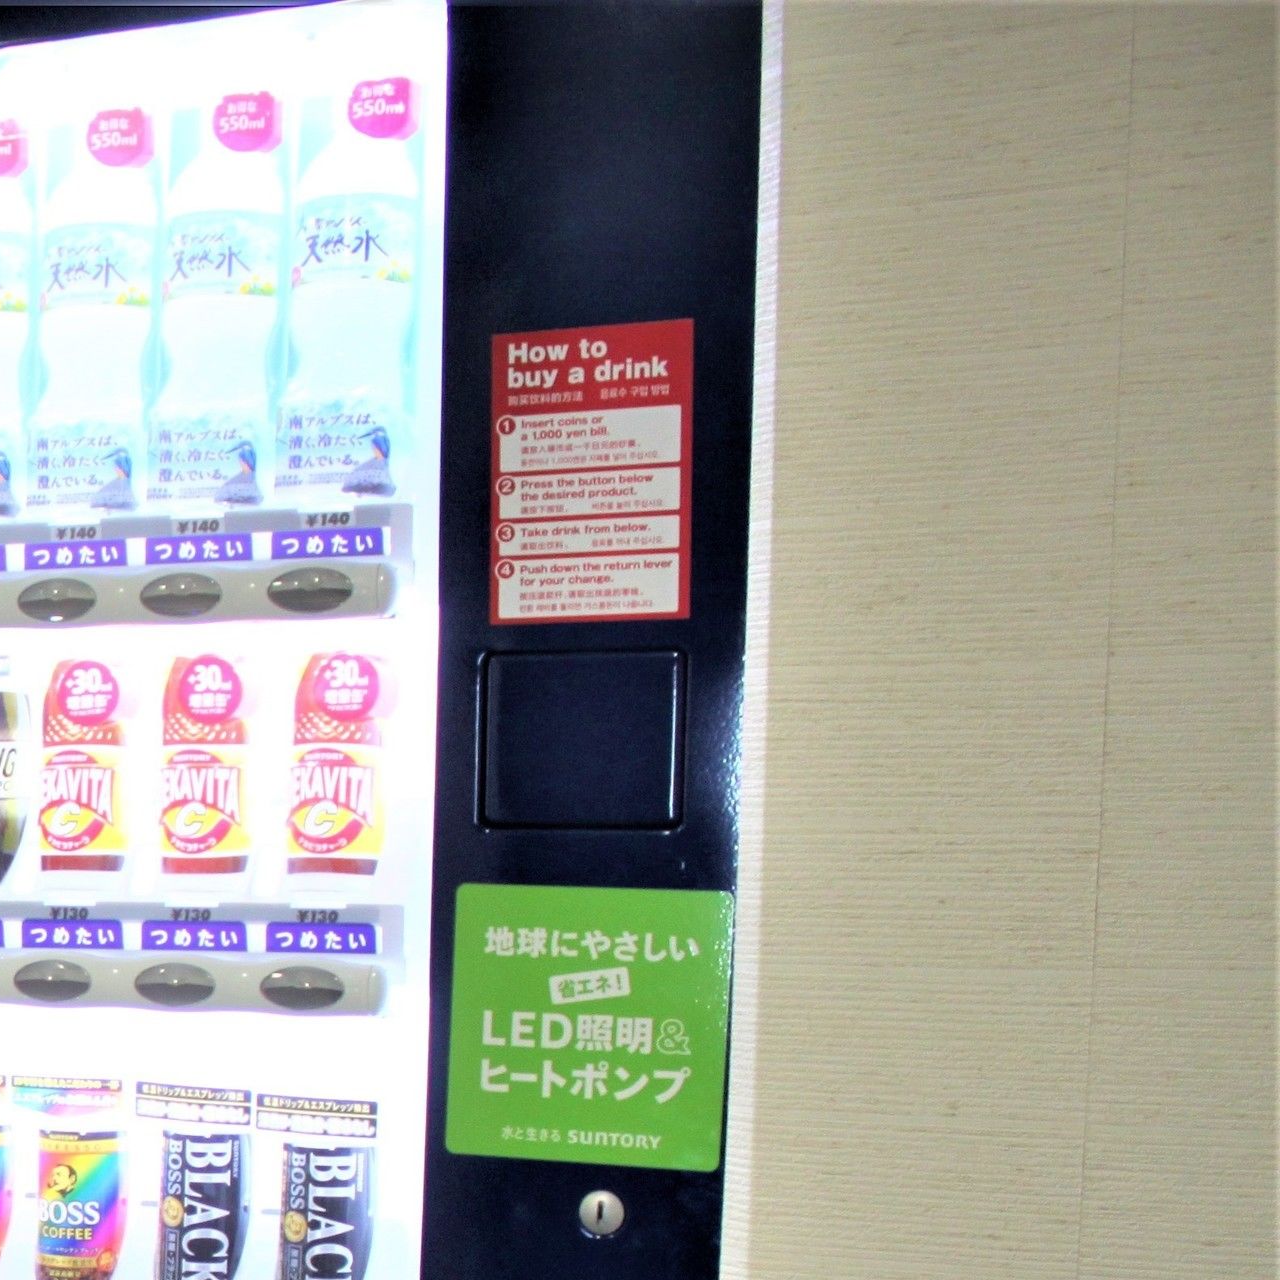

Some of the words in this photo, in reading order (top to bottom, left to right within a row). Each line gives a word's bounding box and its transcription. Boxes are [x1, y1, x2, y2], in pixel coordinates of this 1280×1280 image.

[508, 341, 569, 364] How
[579, 338, 608, 359] to
[508, 366, 558, 389] buy
[568, 366, 585, 384] a
[594, 355, 668, 382] drink
[521, 417, 554, 429] Insert
[558, 416, 588, 427] coins
[591, 416, 604, 424] or
[521, 432, 528, 441] a
[566, 429, 586, 440] yen
[521, 480, 553, 489] Press
[557, 478, 575, 487] the
[578, 476, 616, 486] button
[619, 473, 654, 483] below
[521, 492, 538, 501] the
[542, 489, 585, 500] desired
[176, 519, 220, 534] ¥140
[306, 512, 350, 526] ¥140
[56, 527, 97, 540] ¥140
[521, 527, 548, 538] Take
[551, 525, 580, 536] drink
[584, 524, 610, 535] from
[155, 540, 243, 559] つめたい
[281, 535, 374, 555] つめたい
[33, 546, 118, 565] つめたい
[520, 564, 548, 575] Push
[550, 562, 580, 573] down
[582, 562, 600, 571] the
[603, 561, 640, 570] return
[644, 559, 672, 569] lever
[519, 577, 535, 586] for
[539, 577, 565, 587] your
[49, 906, 89, 920] ¥130
[171, 907, 212, 921] ¥130
[297, 909, 339, 924] ¥130
[30, 925, 116, 945] つめたい
[150, 926, 239, 947] つめたい
[275, 928, 368, 949] つめたい
[485, 926, 700, 963] 地球にやさしい
[480, 1058, 691, 1104] ヒートポンプ
[567, 1129, 662, 1150] SUNTORY
[168, 1140, 183, 1195] BOSS
[291, 1152, 306, 1209] BOSS
[42, 1225, 93, 1240] COFFEE
